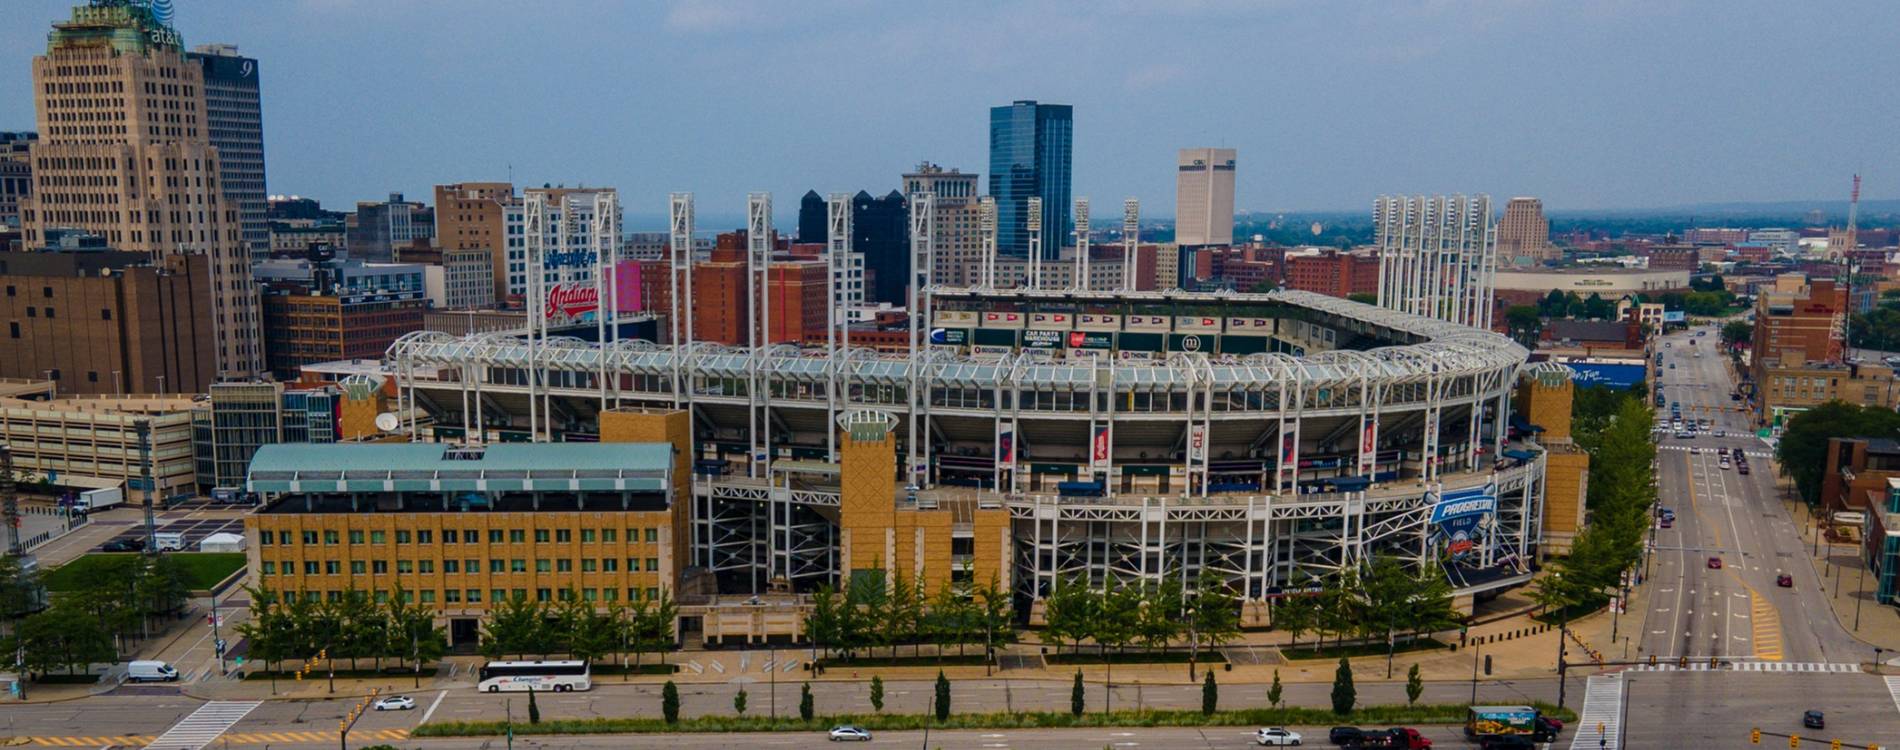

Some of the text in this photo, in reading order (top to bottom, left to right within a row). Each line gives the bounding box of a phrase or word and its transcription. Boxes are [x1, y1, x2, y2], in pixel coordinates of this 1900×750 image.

[152, 27, 180, 46] at&t
[240, 60, 253, 78] 9
[545, 283, 598, 318] Indian
[1193, 431, 1203, 449] CLE
[1441, 499, 1493, 517] PROGRESSIVE
[1452, 517, 1472, 527] FIELD
